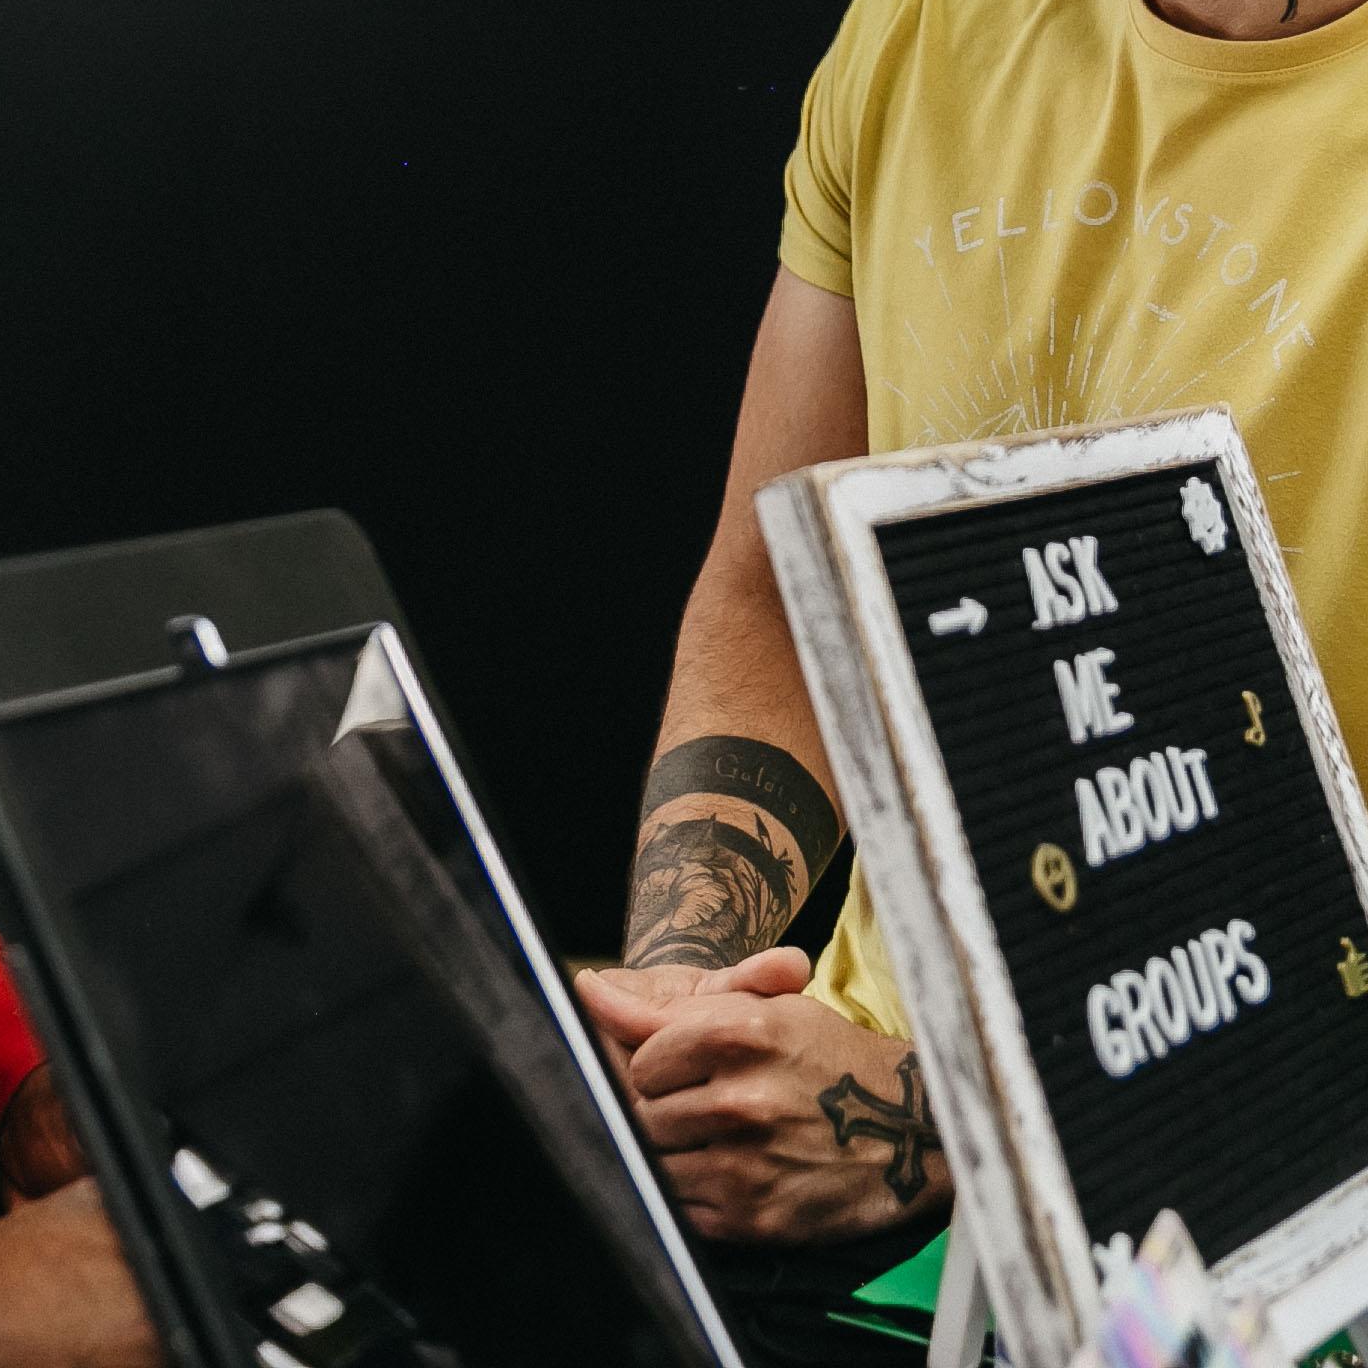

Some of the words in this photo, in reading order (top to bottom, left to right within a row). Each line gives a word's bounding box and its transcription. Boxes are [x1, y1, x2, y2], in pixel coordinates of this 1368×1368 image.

[914, 181, 1317, 370] YELLOWSTONE
[1023, 536, 1119, 630] ASK
[1053, 647, 1134, 744] ME
[1075, 746, 1219, 868] ABOUT
[1087, 918, 1271, 1079] GROUPS
